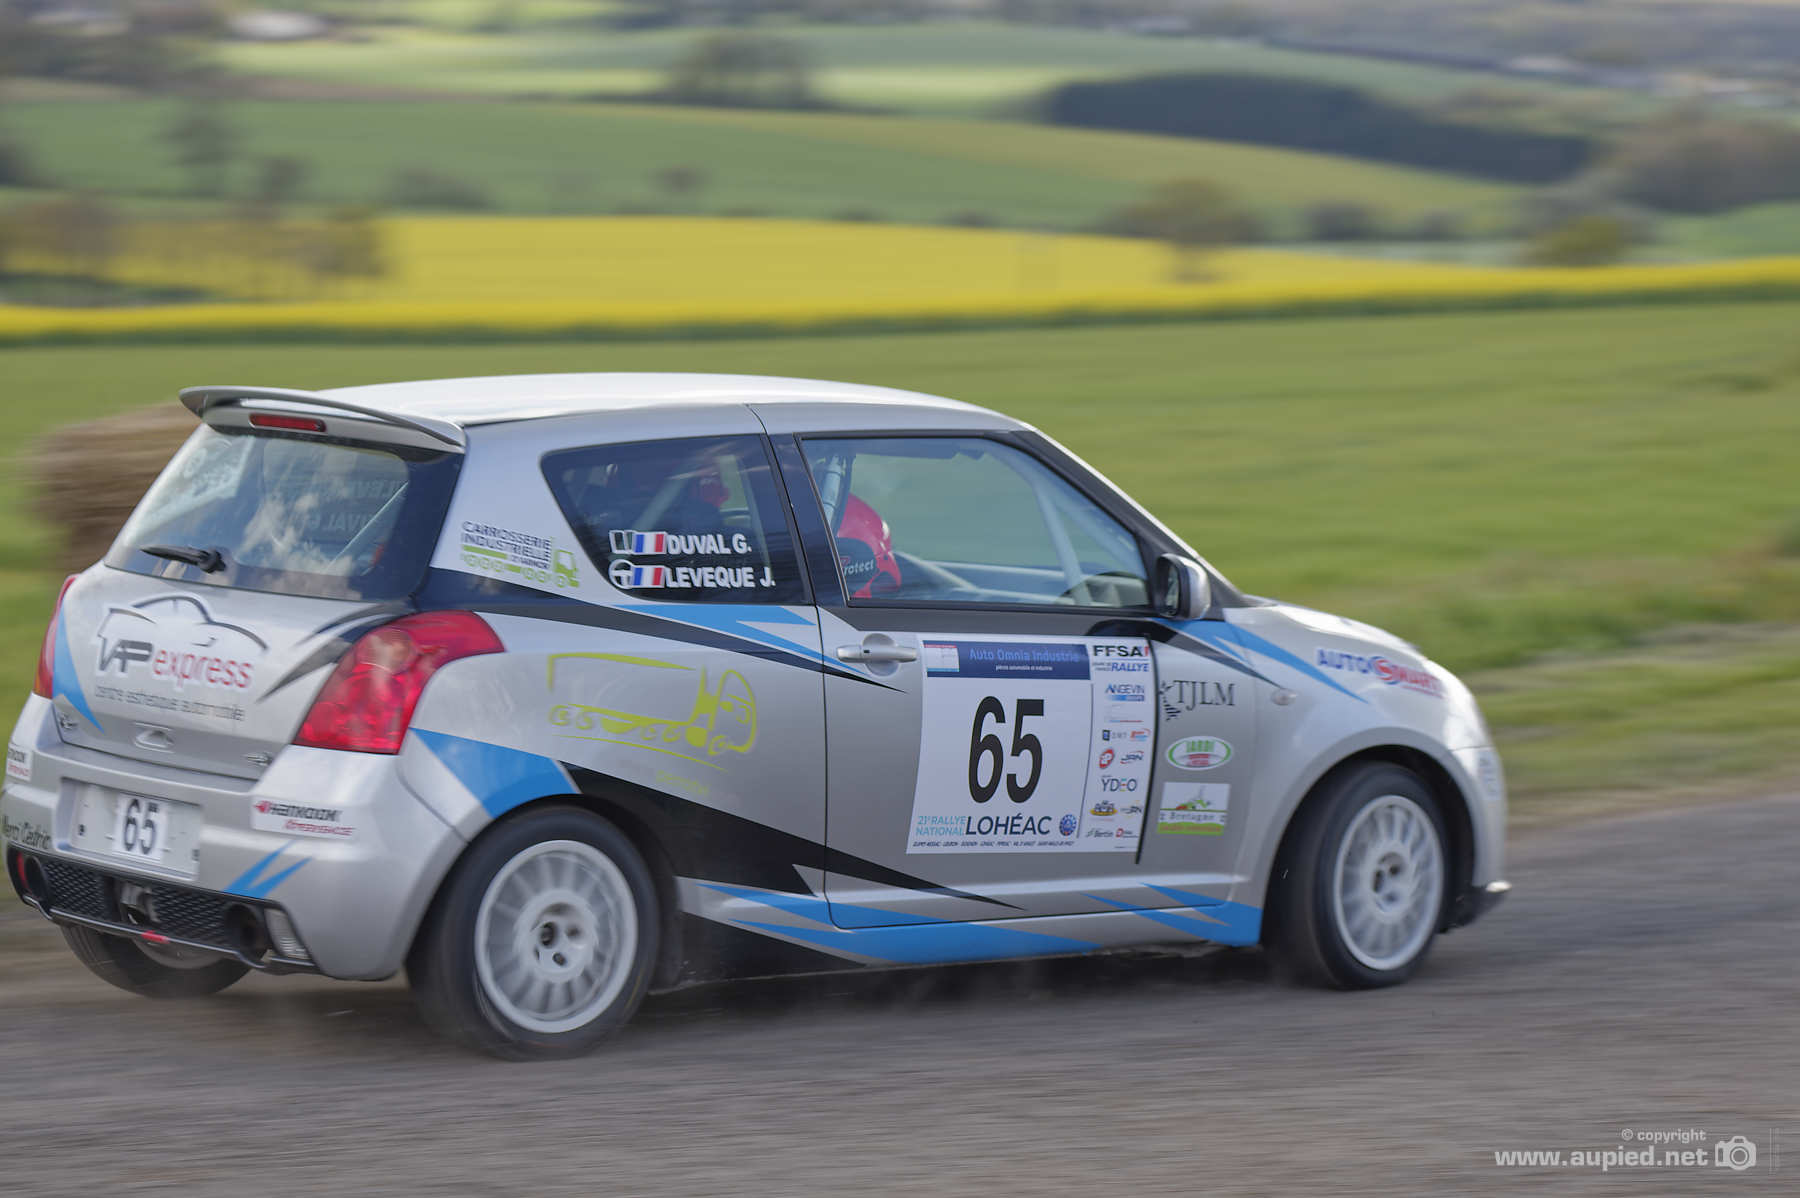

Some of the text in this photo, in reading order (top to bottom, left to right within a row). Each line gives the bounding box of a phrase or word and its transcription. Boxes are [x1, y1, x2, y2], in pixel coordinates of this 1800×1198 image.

[667, 533, 752, 554] DUVAL G.
[666, 566, 776, 588] LEVEQUE J.
[969, 648, 1080, 662] Auto Omnia Industrie
[1093, 645, 1143, 657] FFSA
[152, 649, 252, 689] express
[1111, 662, 1149, 672] RALLYE
[1173, 680, 1236, 711] TJLM
[968, 695, 1045, 804] 65
[1101, 778, 1137, 792] YDEO
[123, 798, 158, 852] 65
[931, 816, 966, 825] RALLYE
[965, 813, 1052, 836] LOHÉAC
[915, 826, 964, 837] NATIONAL
